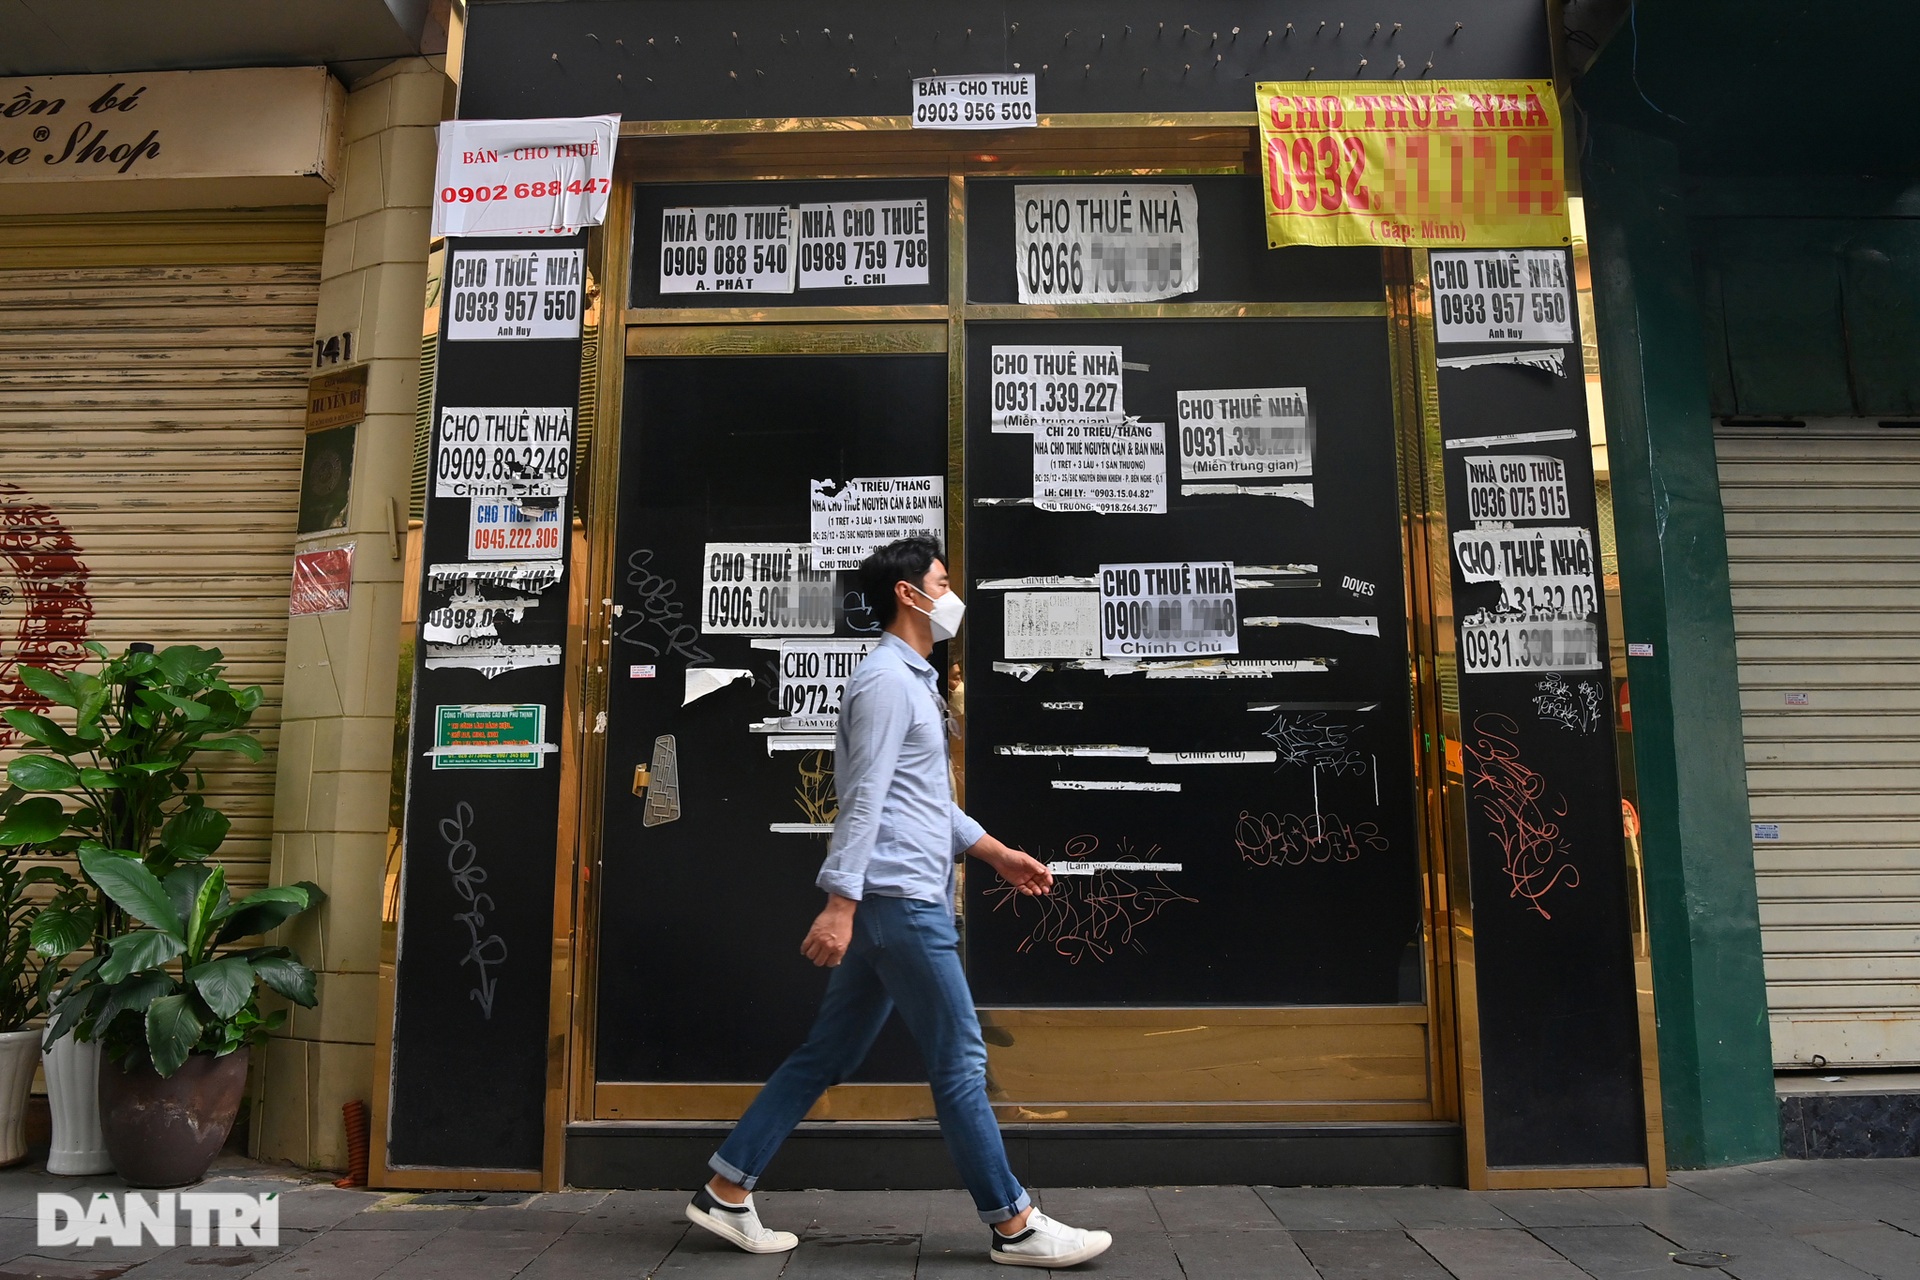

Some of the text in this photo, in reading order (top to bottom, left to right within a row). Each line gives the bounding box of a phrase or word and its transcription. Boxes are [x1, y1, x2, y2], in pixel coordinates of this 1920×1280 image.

[919, 79, 946, 96] BÁN
[959, 81, 987, 96] CHO
[992, 77, 1028, 95] THUÊ
[917, 102, 1031, 122] 0903 956 500
[1269, 85, 1549, 129] CHO THUÊ NHÀ
[44, 121, 160, 174] Shop
[463, 147, 498, 164] BÁN
[513, 146, 549, 161] CHO
[553, 140, 599, 158] THUÊ
[441, 178, 610, 203] 0902 688 447
[802, 201, 925, 238] NHÀ CHO THUÊ
[1025, 190, 1183, 233] CHO THUÊ NHÀ
[664, 207, 788, 242] NHÀ CHO THUÊ
[1421, 221, 1466, 241] Minh)
[664, 244, 787, 276] 0909 088 540
[802, 239, 927, 272] 0989 759 798
[1028, 242, 1084, 294] 0966
[454, 251, 580, 288] CHO THUÊ NHÀ
[844, 273, 886, 285] C. CHI
[1434, 253, 1565, 290] CHO THUÊ NHÀ
[696, 277, 754, 290] A. PHÁT
[454, 290, 576, 323] 0933 957 550
[1441, 292, 1566, 325] 0933 957 550
[497, 326, 531, 337] Anh Huy
[1489, 328, 1523, 339] Anh Huy
[315, 332, 351, 367] 141
[993, 351, 1119, 375] CHO THUÊ NHÀ
[995, 382, 1118, 412] 0931.339.227
[1179, 393, 1305, 419] CHO THUÊ NHÀ
[442, 409, 570, 442] CHO THUÊ NHÀ
[1067, 427, 1080, 437] 20
[1050, 442, 1064, 455] CHO
[1193, 459, 1299, 474] (Miễn trung gian)
[1470, 460, 1527, 483] NHÀ CHO
[453, 483, 508, 497] Chính
[1045, 489, 1057, 498] LH:
[1075, 489, 1086, 498] LY:
[1472, 486, 1567, 518] 0936 075 915
[477, 505, 498, 523] CHO
[475, 527, 559, 550] 0945.222.306
[822, 546, 835, 555] LH:
[853, 545, 864, 554] LY:
[710, 548, 792, 582] CHO THUÊ
[1458, 530, 1591, 577] CHO THUÊ NHÀ
[1103, 563, 1233, 597] CHO THUÊ NHÀ
[1342, 575, 1376, 597] DOVES
[1121, 640, 1222, 654] Chính Chủ
[784, 652, 820, 678] CHO
